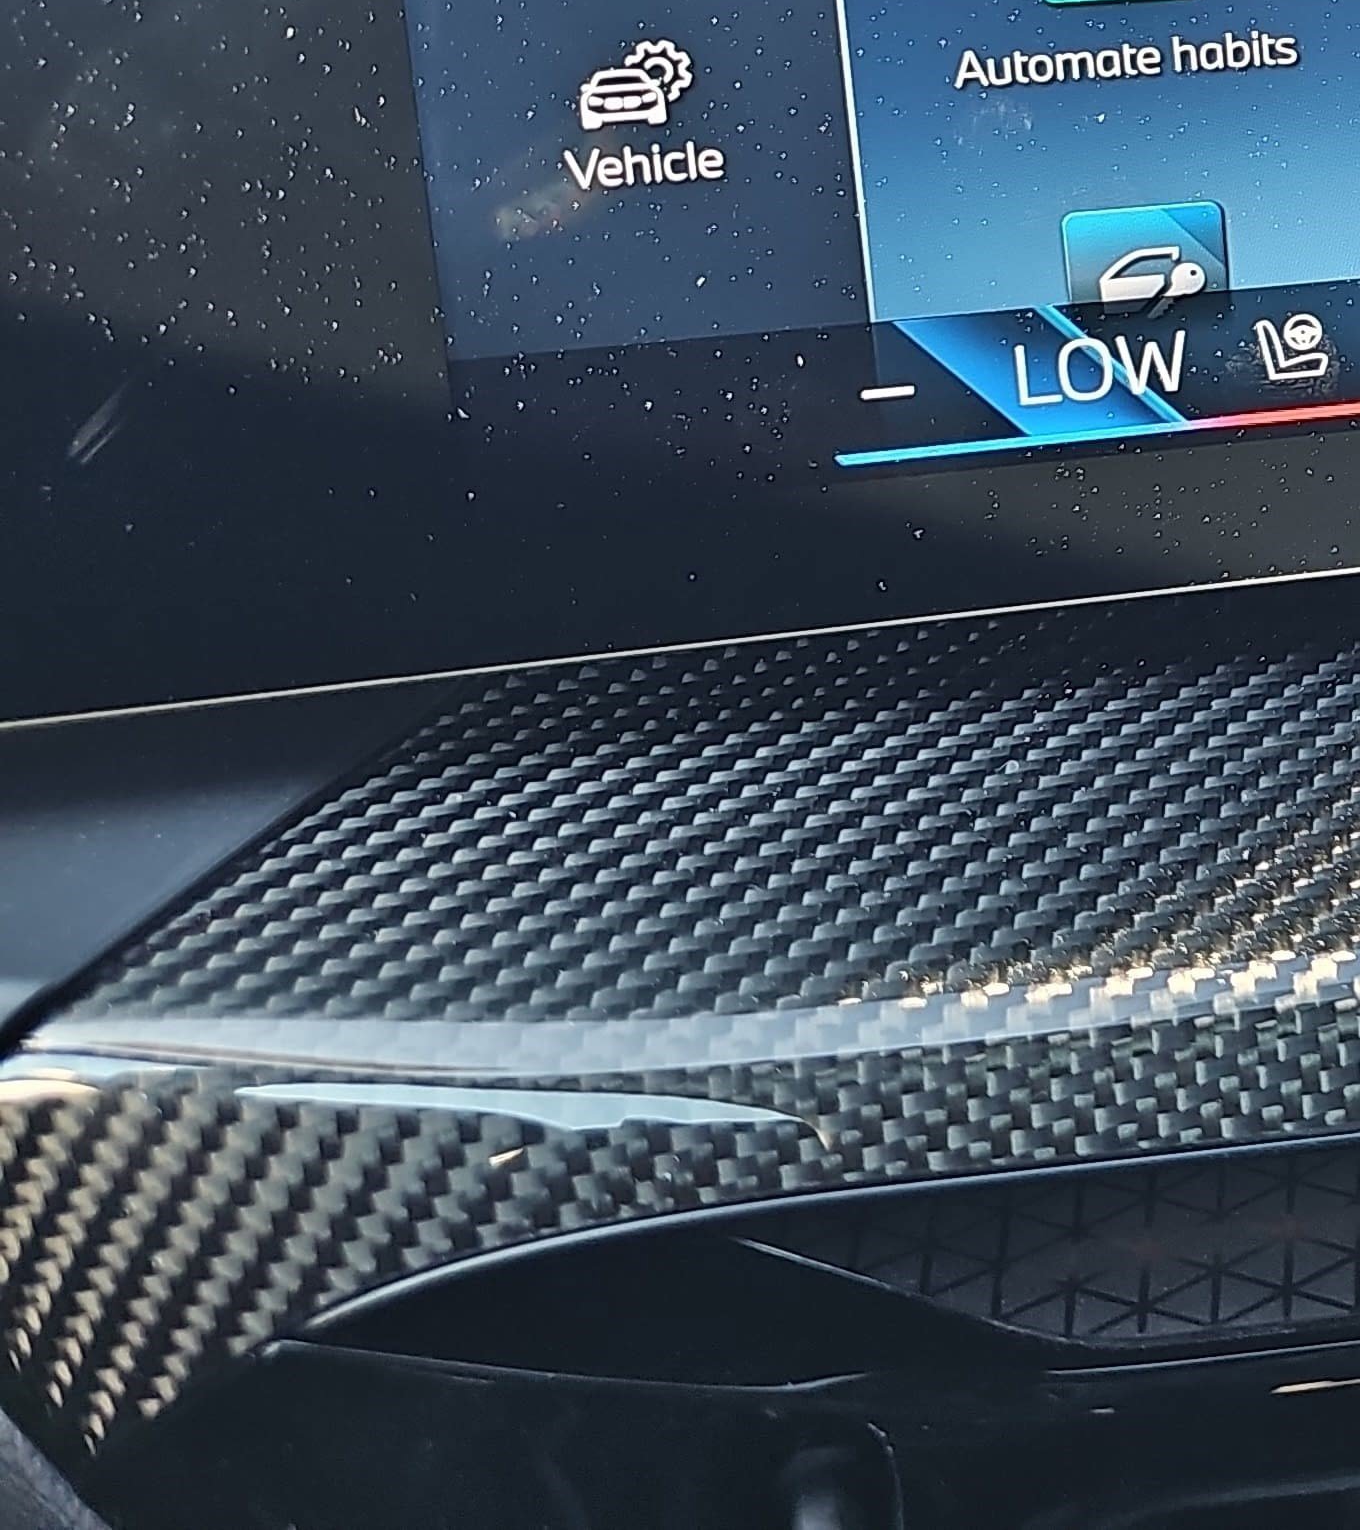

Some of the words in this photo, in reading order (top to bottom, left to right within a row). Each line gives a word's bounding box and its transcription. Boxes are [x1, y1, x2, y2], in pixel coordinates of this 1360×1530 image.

[954, 44, 1161, 91] Automate
[1172, 32, 1298, 73] habits
[563, 141, 726, 191] Vehicle
[1014, 330, 1187, 408] LOW
